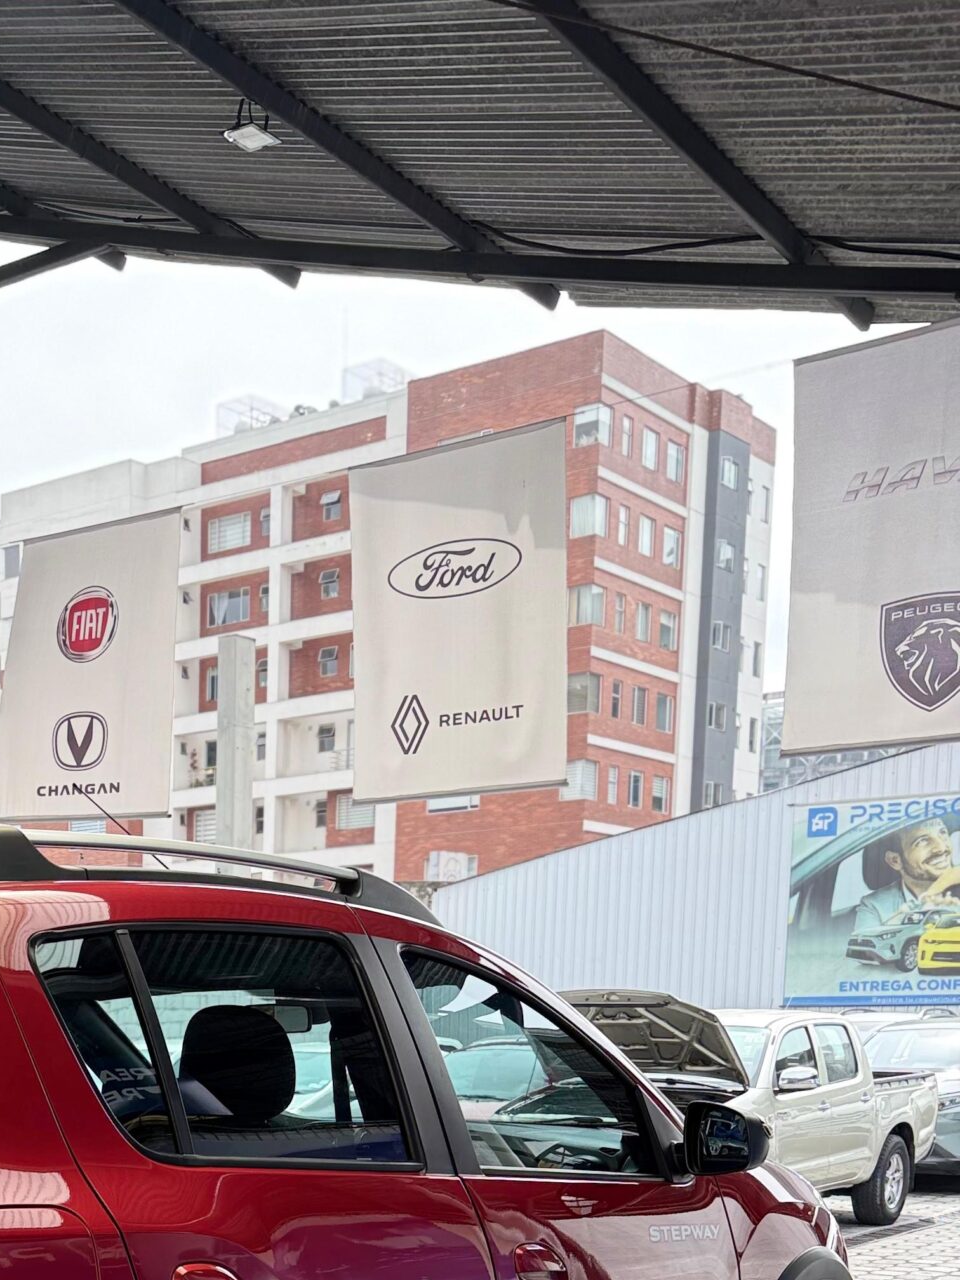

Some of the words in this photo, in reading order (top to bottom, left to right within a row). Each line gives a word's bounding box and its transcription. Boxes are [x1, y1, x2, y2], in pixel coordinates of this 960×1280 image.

[843, 455, 960, 503] HAV
[415, 546, 495, 592] Ford
[891, 602, 960, 621] PEUGE
[71, 607, 107, 643] FIAT
[439, 704, 525, 728] RENAULT
[36, 782, 121, 797] CHANGAN
[839, 979, 914, 993] ENTREGA
[649, 1224, 720, 1243] STEPWAY
